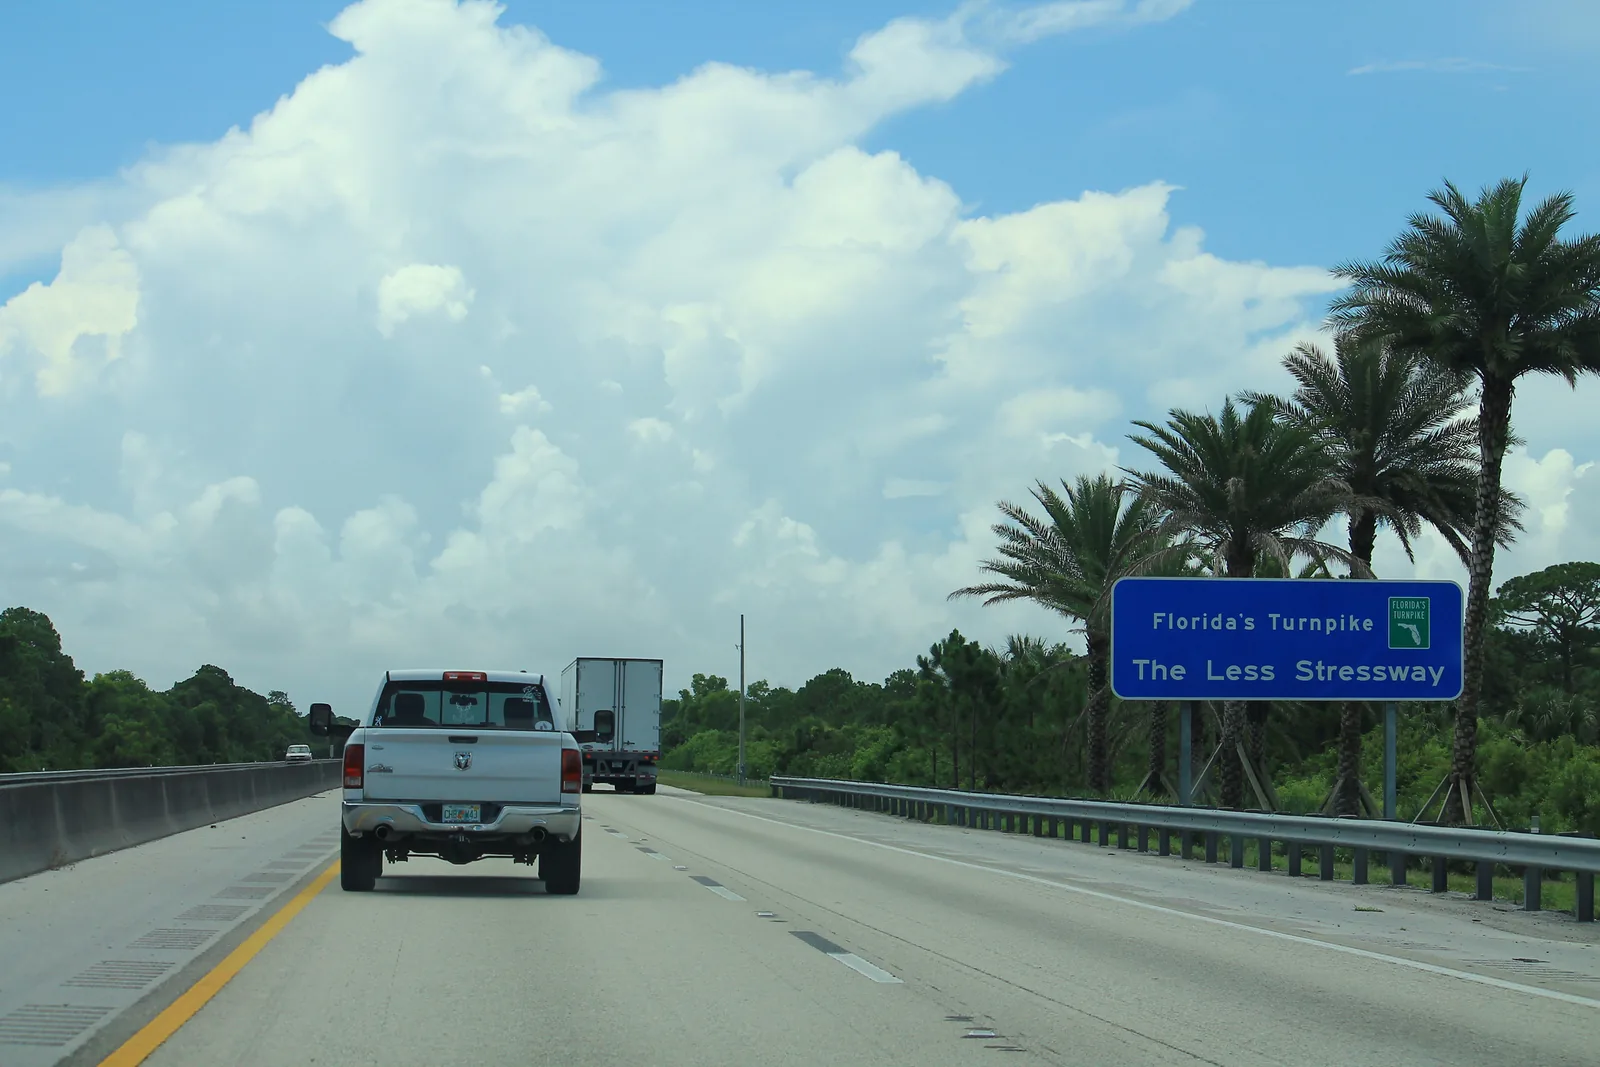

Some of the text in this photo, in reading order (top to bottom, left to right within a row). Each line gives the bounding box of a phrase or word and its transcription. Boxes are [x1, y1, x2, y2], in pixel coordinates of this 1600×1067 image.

[1392, 600, 1426, 610] FLORIDA'S
[1393, 610, 1425, 620] TURNPIKE
[1153, 612, 1374, 635] Florida's Turnpike
[1133, 659, 1445, 687] The Less Stressway
